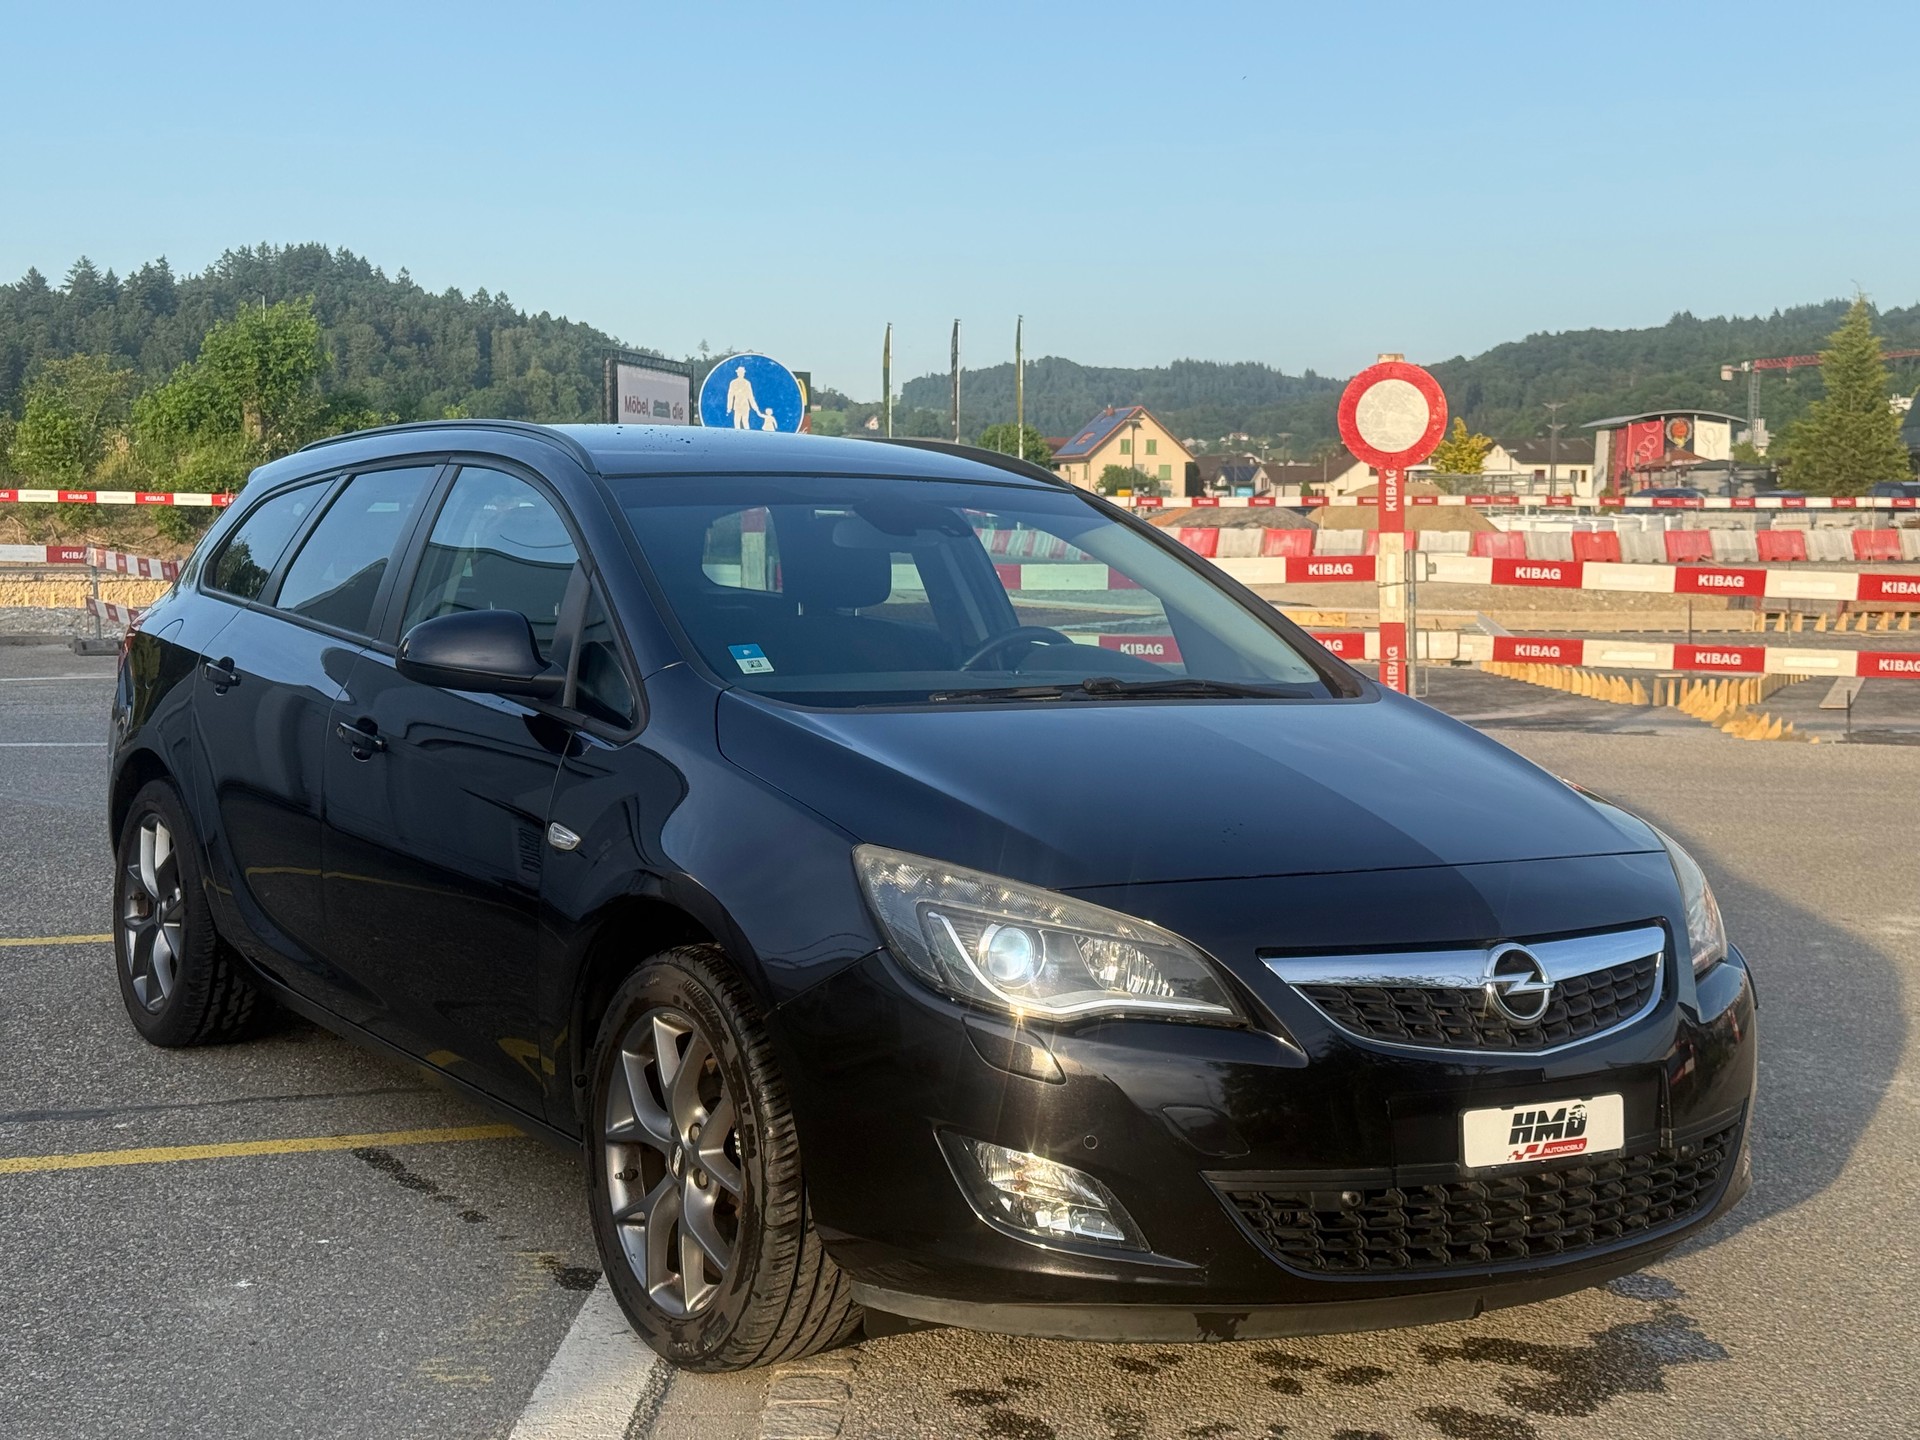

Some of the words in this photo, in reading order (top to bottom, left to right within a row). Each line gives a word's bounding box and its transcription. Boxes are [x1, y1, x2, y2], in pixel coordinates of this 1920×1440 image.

[1308, 563, 1354, 576] KIBAG
[1515, 566, 1562, 580] KIBAG
[1697, 574, 1745, 588] KIBAG
[1120, 643, 1164, 655] KIBAG
[1515, 644, 1561, 658] KIBAG
[1695, 652, 1742, 665] KIBAG
